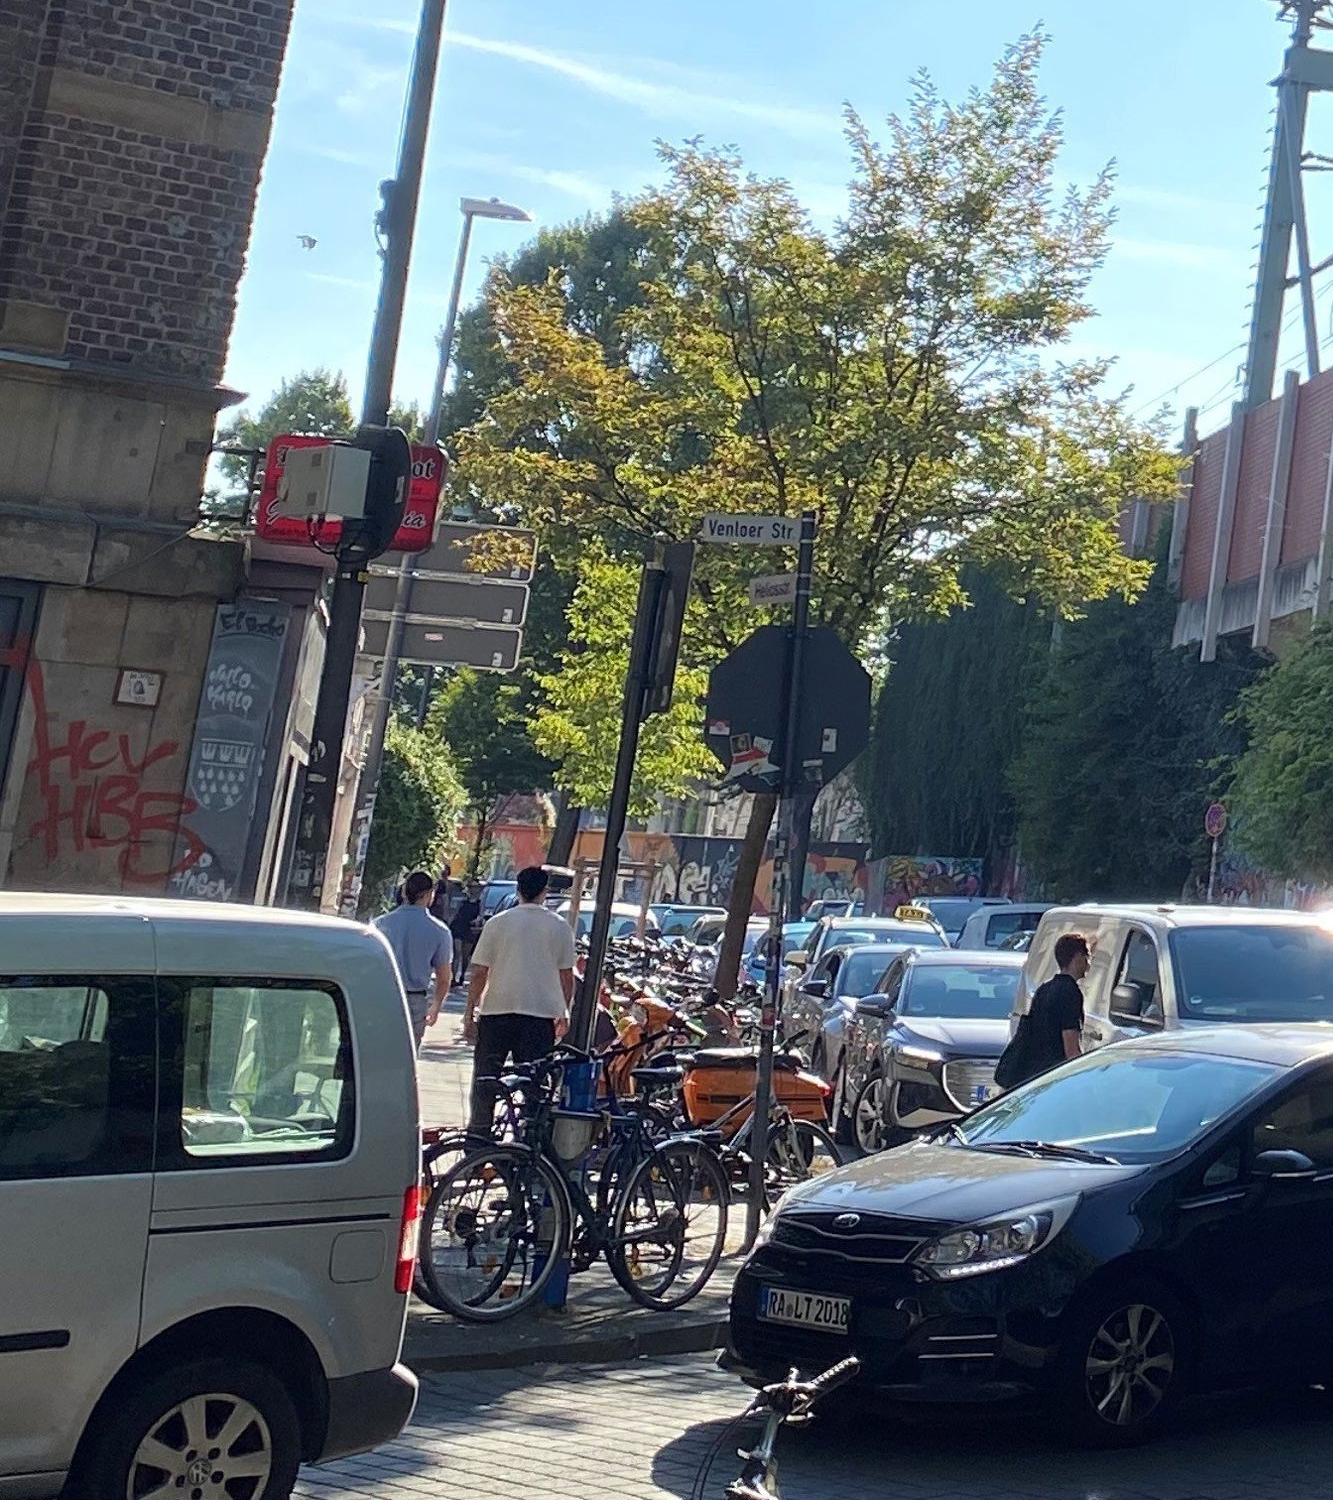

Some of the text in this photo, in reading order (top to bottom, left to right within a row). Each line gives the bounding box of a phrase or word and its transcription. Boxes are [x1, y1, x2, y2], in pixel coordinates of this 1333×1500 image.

[708, 518, 763, 538] Venloer
[900, 907, 924, 919] TAXI
[769, 1291, 850, 1327] RA LT 2018
